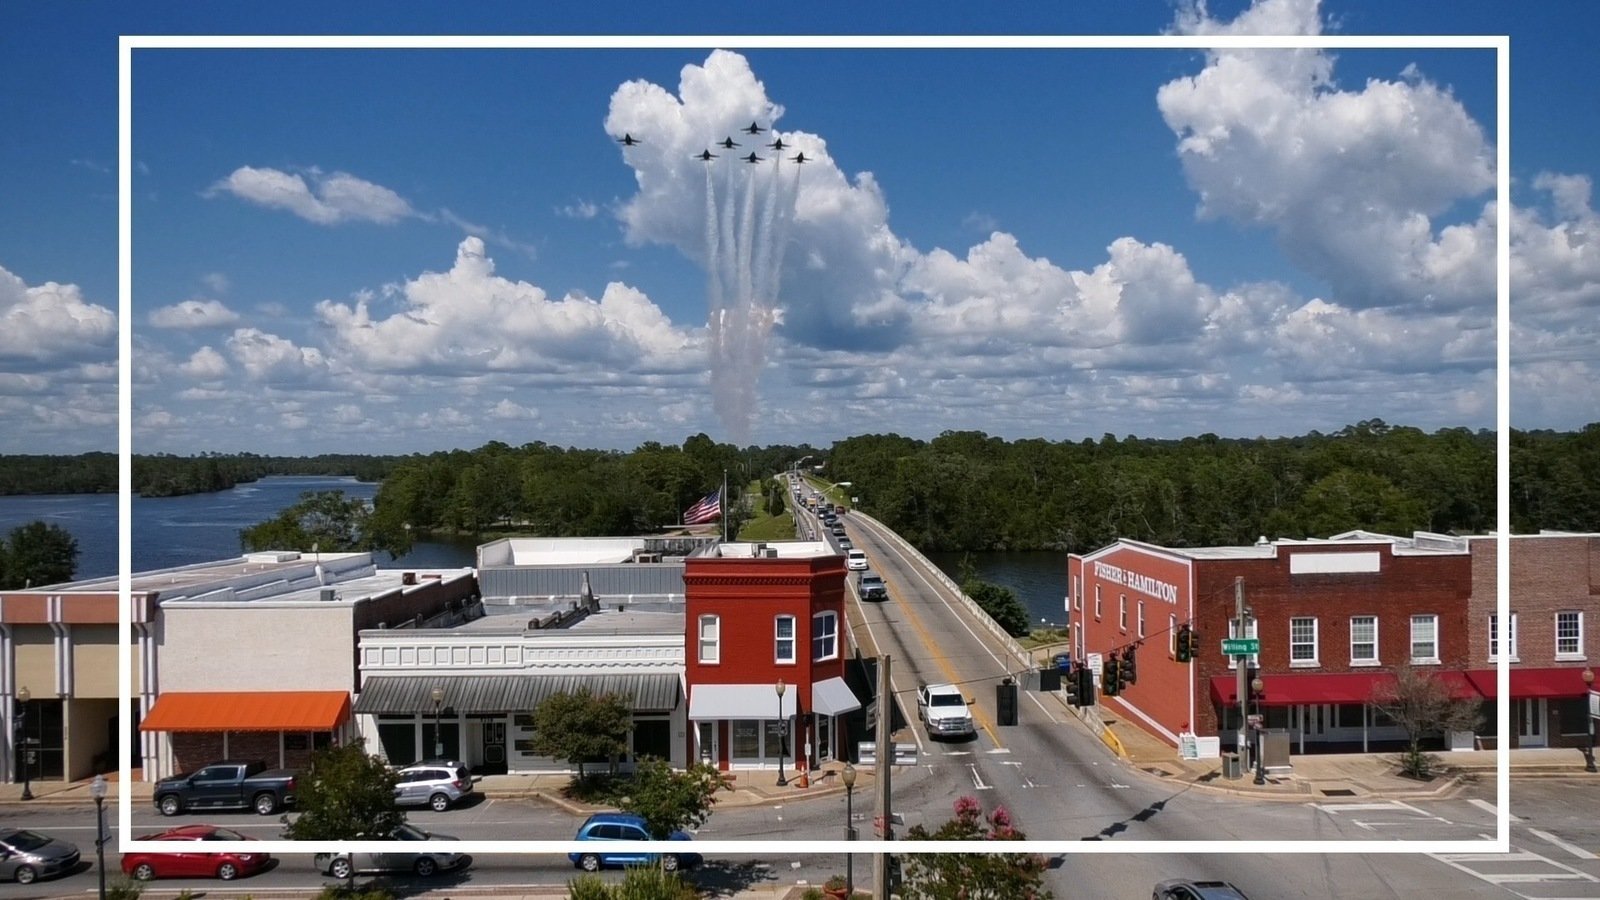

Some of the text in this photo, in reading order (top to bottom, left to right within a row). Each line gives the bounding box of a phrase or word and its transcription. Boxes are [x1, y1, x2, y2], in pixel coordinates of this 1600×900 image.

[1094, 561, 1122, 584] FISHER
[1127, 571, 1177, 605] HAMILTON
[1223, 643, 1247, 652] Willing
